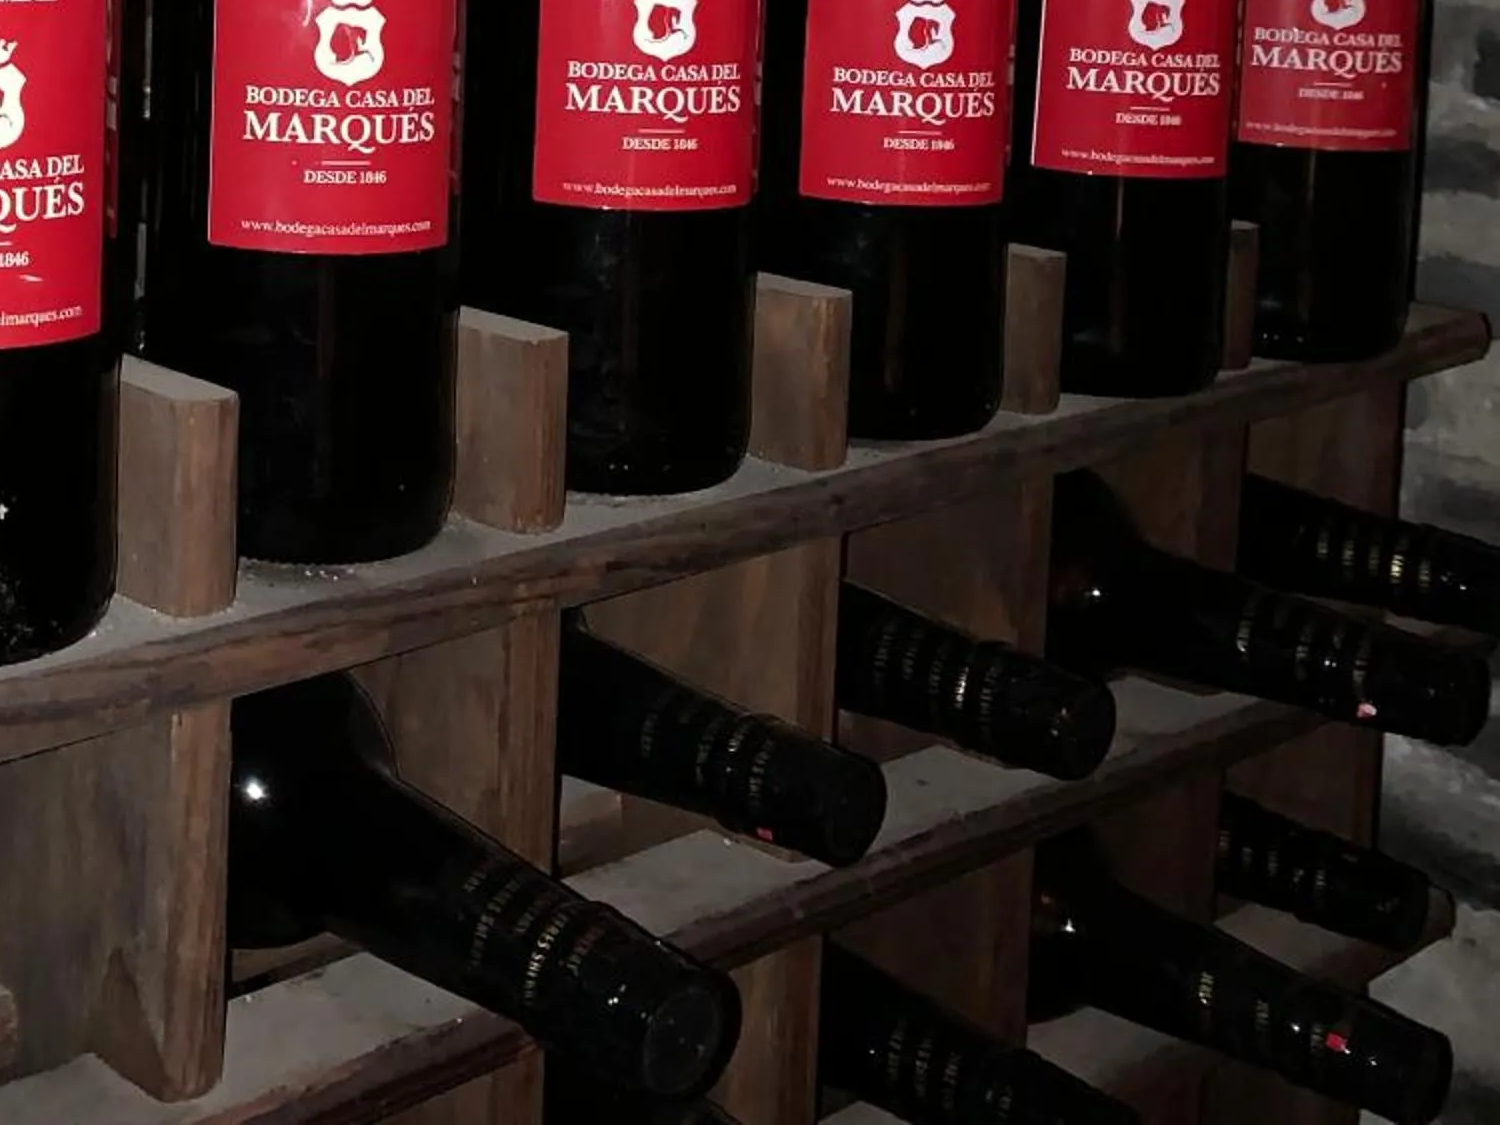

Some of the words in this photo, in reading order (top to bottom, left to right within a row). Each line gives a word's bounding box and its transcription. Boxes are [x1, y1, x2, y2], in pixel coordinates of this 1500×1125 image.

[1253, 26, 1330, 47] BODEGA
[1334, 33, 1375, 47] CASA
[1377, 34, 1401, 48] DEL
[1069, 48, 1148, 68] BODEGA
[1151, 53, 1193, 68] CASA
[1194, 54, 1220, 68] DEL
[568, 61, 656, 81] BODEGA
[660, 65, 709, 81] CASA
[712, 64, 740, 80] DEL
[832, 67, 916, 89] BODEGA
[919, 73, 966, 87] CASA
[968, 72, 994, 88] DEL
[1066, 66, 1219, 101] MARQUÉS
[246, 85, 340, 107] BODEGA
[345, 90, 398, 108] CASA
[402, 88, 434, 106] DEL
[566, 81, 740, 123] MARQUÉS
[830, 86, 994, 125] MARQUÉS
[243, 105, 434, 154] MARQUÉS
[623, 137, 671, 150] DESDE
[884, 137, 929, 150] DESDE
[46, 155, 84, 178] DEL
[304, 170, 356, 184] DESDE
[360, 171, 386, 184] 1846
